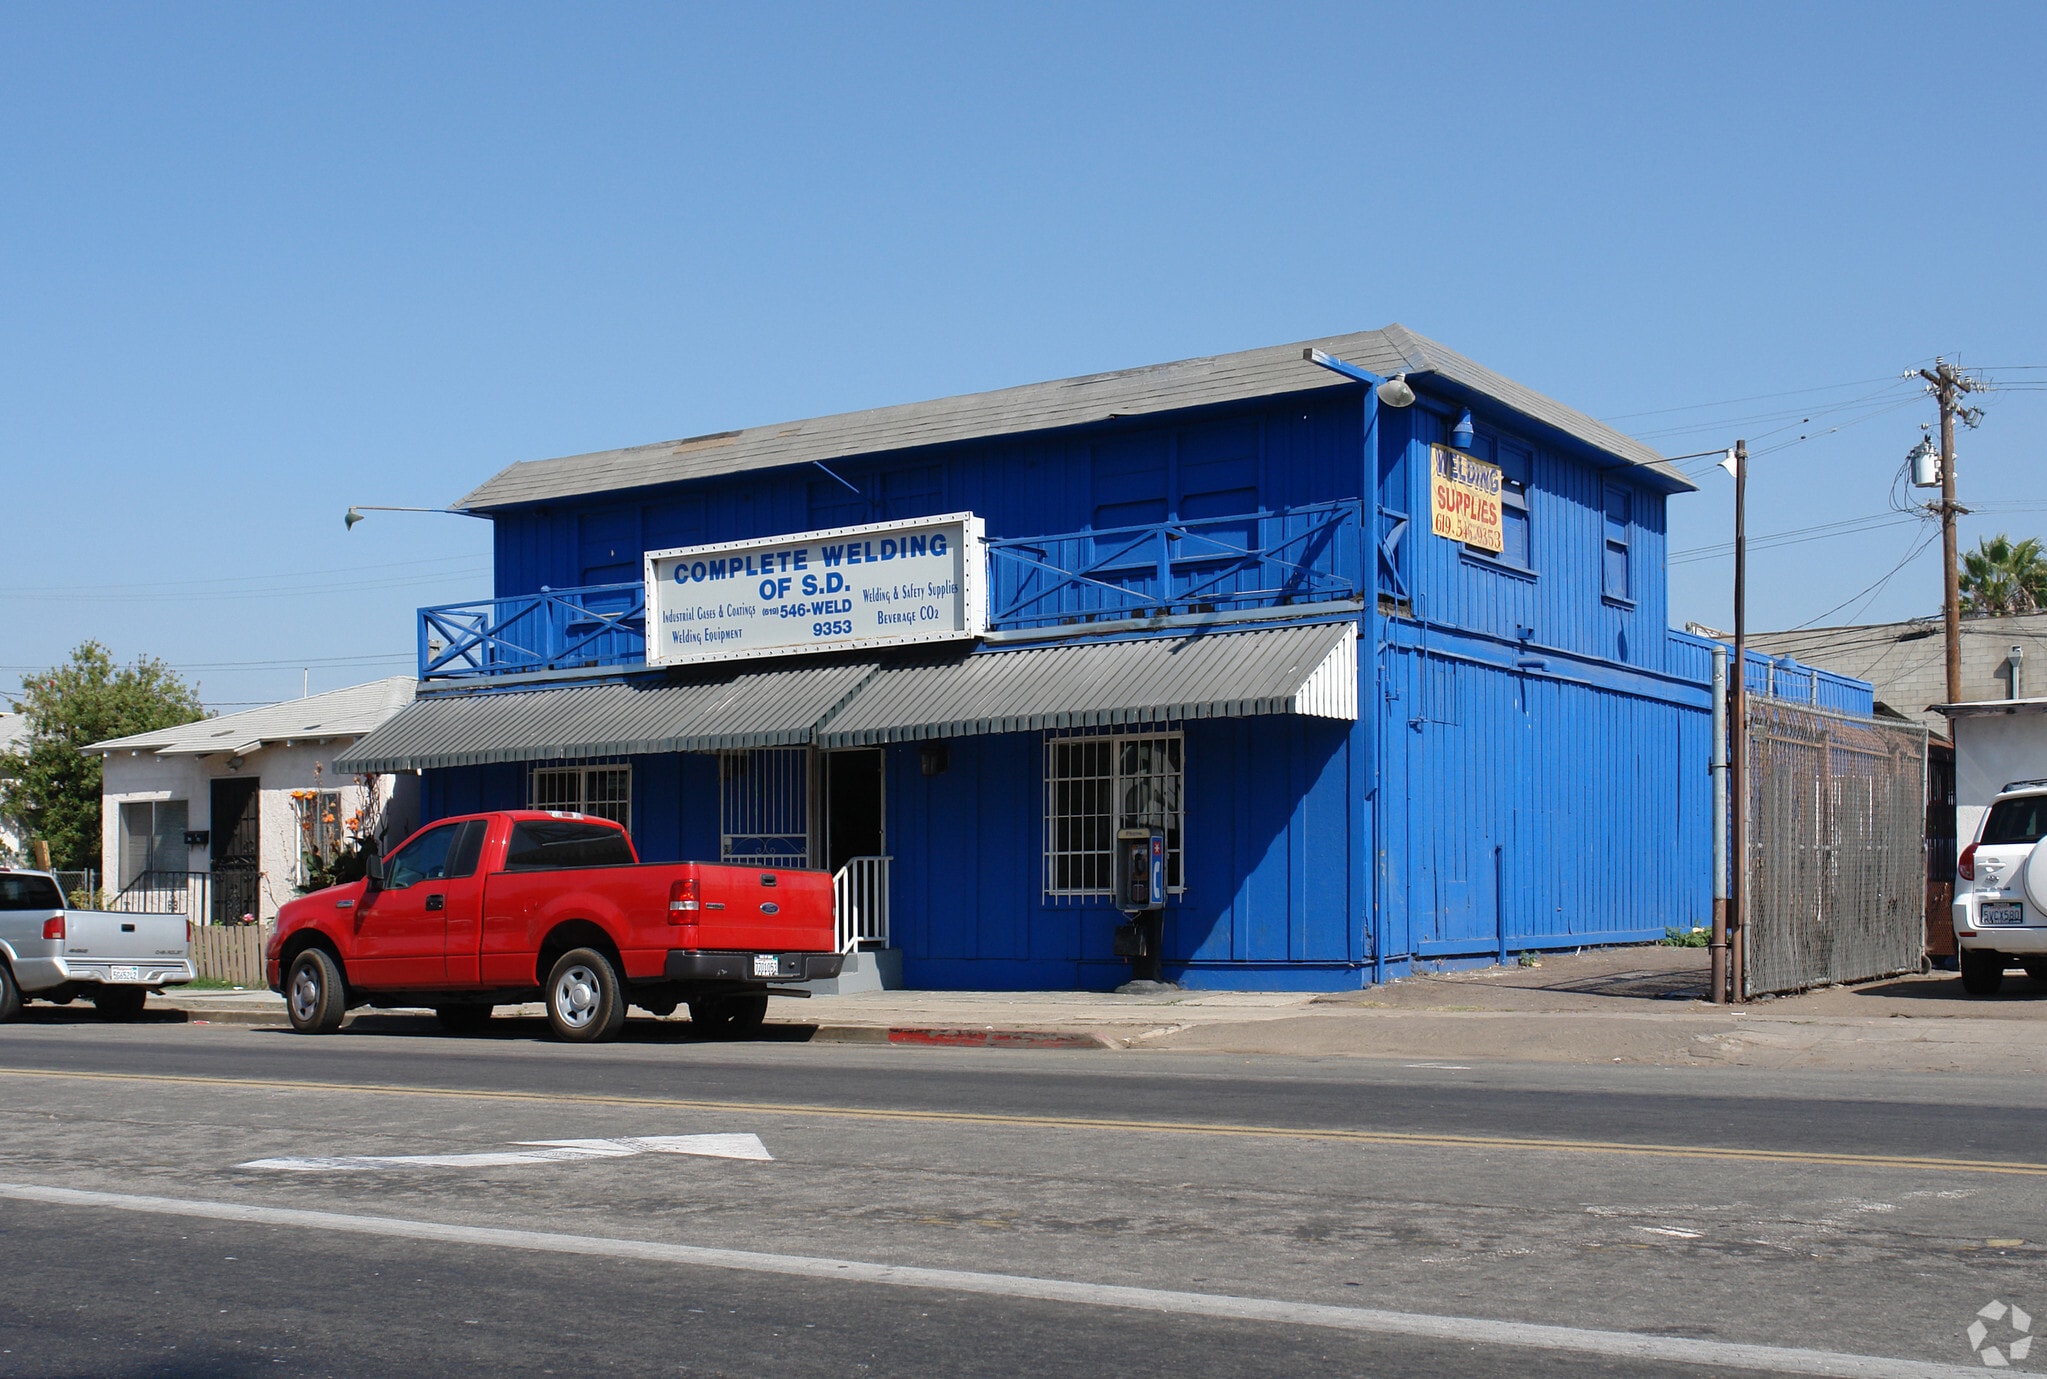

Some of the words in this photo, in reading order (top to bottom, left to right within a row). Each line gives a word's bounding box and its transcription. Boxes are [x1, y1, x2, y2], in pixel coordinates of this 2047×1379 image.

[1436, 448, 1499, 495] WELDING
[1437, 485, 1497, 525] SUPPLIES
[674, 549, 808, 585] COMPLETE
[822, 533, 948, 567] WELDING
[759, 578, 792, 601] OF
[801, 572, 851, 597] S.D.
[893, 585, 899, 600] &
[927, 579, 959, 599] Supplies
[718, 604, 724, 618] &
[813, 619, 853, 637] 9353
